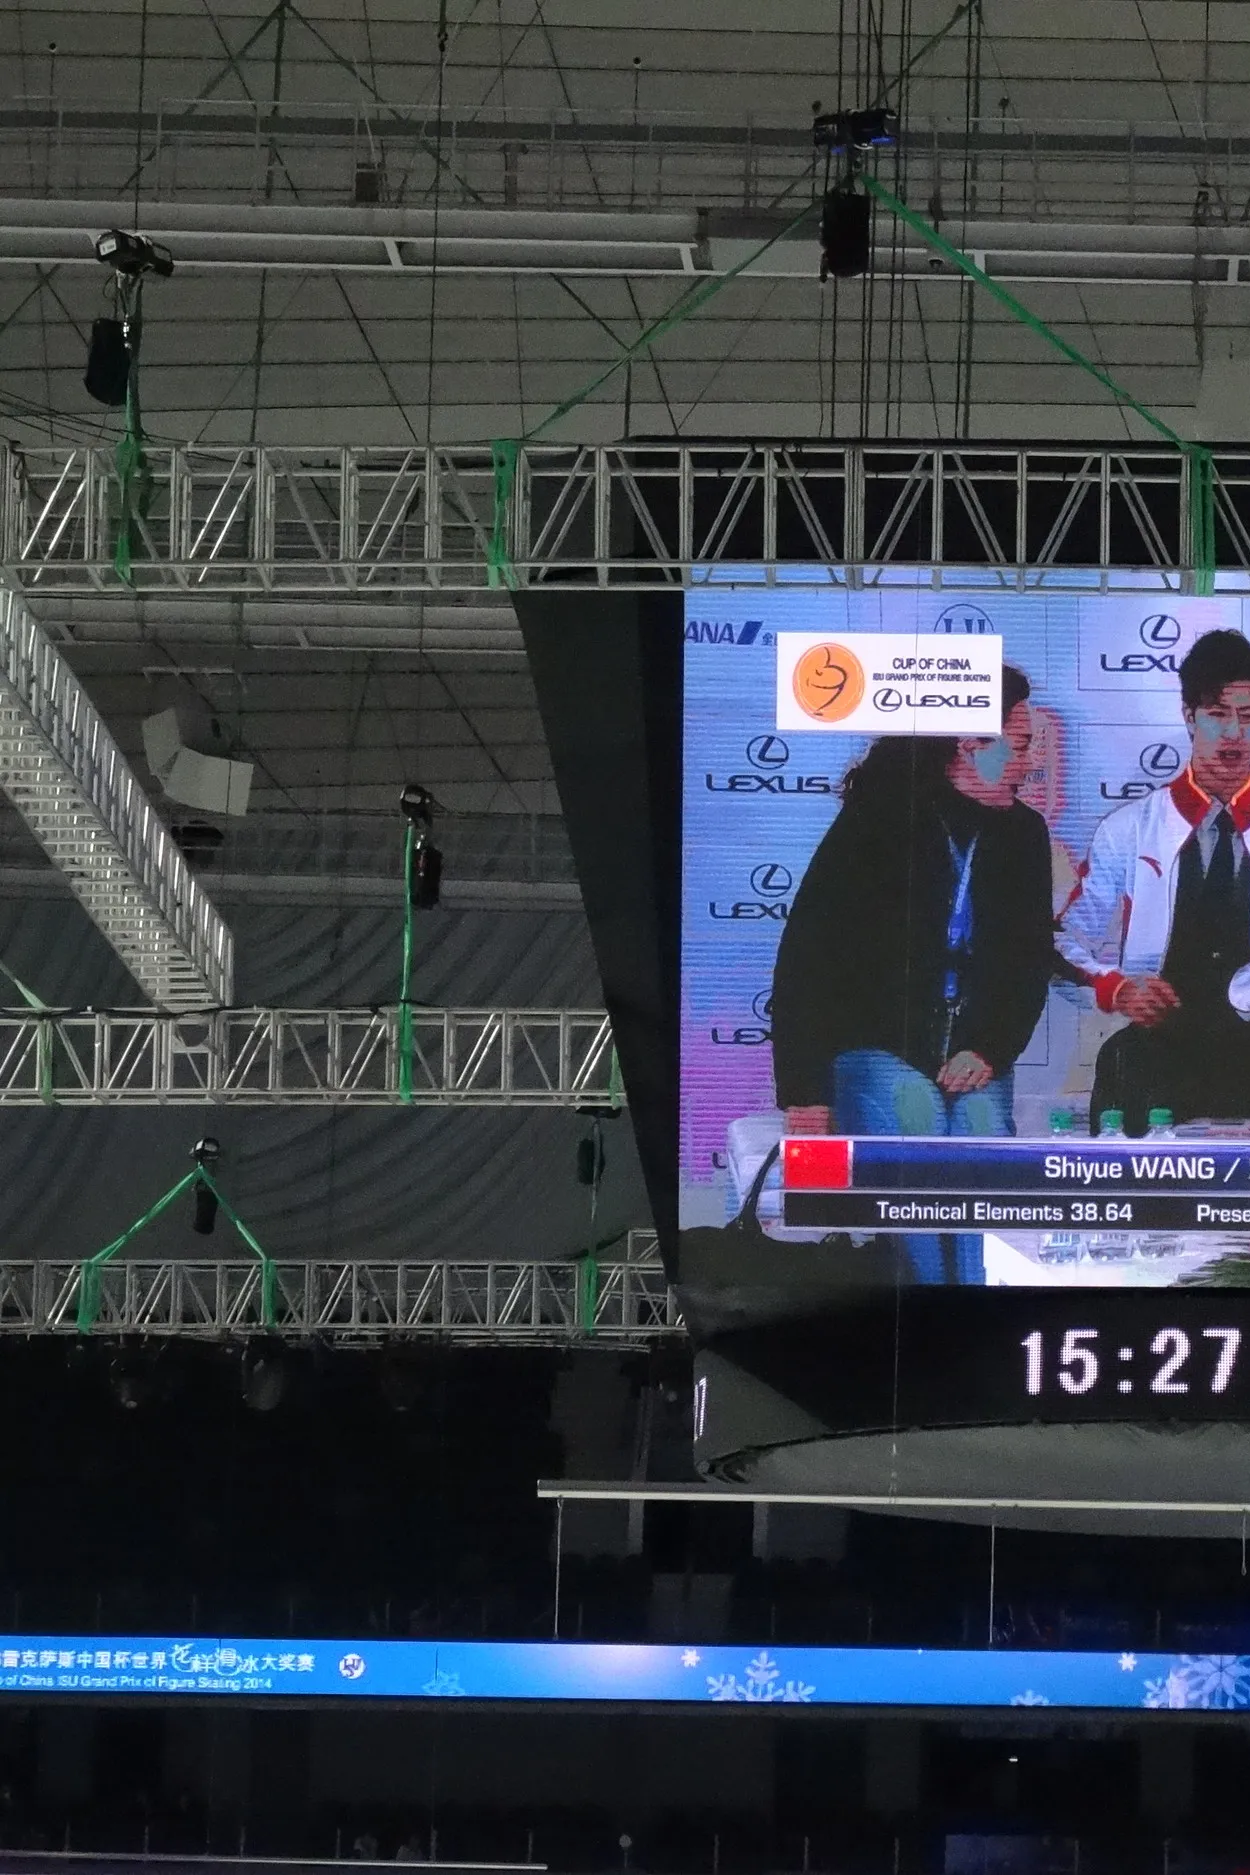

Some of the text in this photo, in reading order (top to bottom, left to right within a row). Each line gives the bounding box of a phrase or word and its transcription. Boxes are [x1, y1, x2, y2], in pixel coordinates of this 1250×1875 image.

[892, 657, 972, 671] CUP OF CHINA
[1100, 653, 1180, 673] LEX
[905, 694, 991, 708] LEXUS
[705, 773, 832, 794] LEXUS
[709, 901, 788, 920] LEX
[1044, 1155, 1123, 1185] Shiyue
[1131, 1156, 1216, 1180] WANG
[876, 1201, 1133, 1222] Technical Elements 38.64
[120, 1676, 141, 1688] Prix
[158, 1676, 195, 1691] Figure
